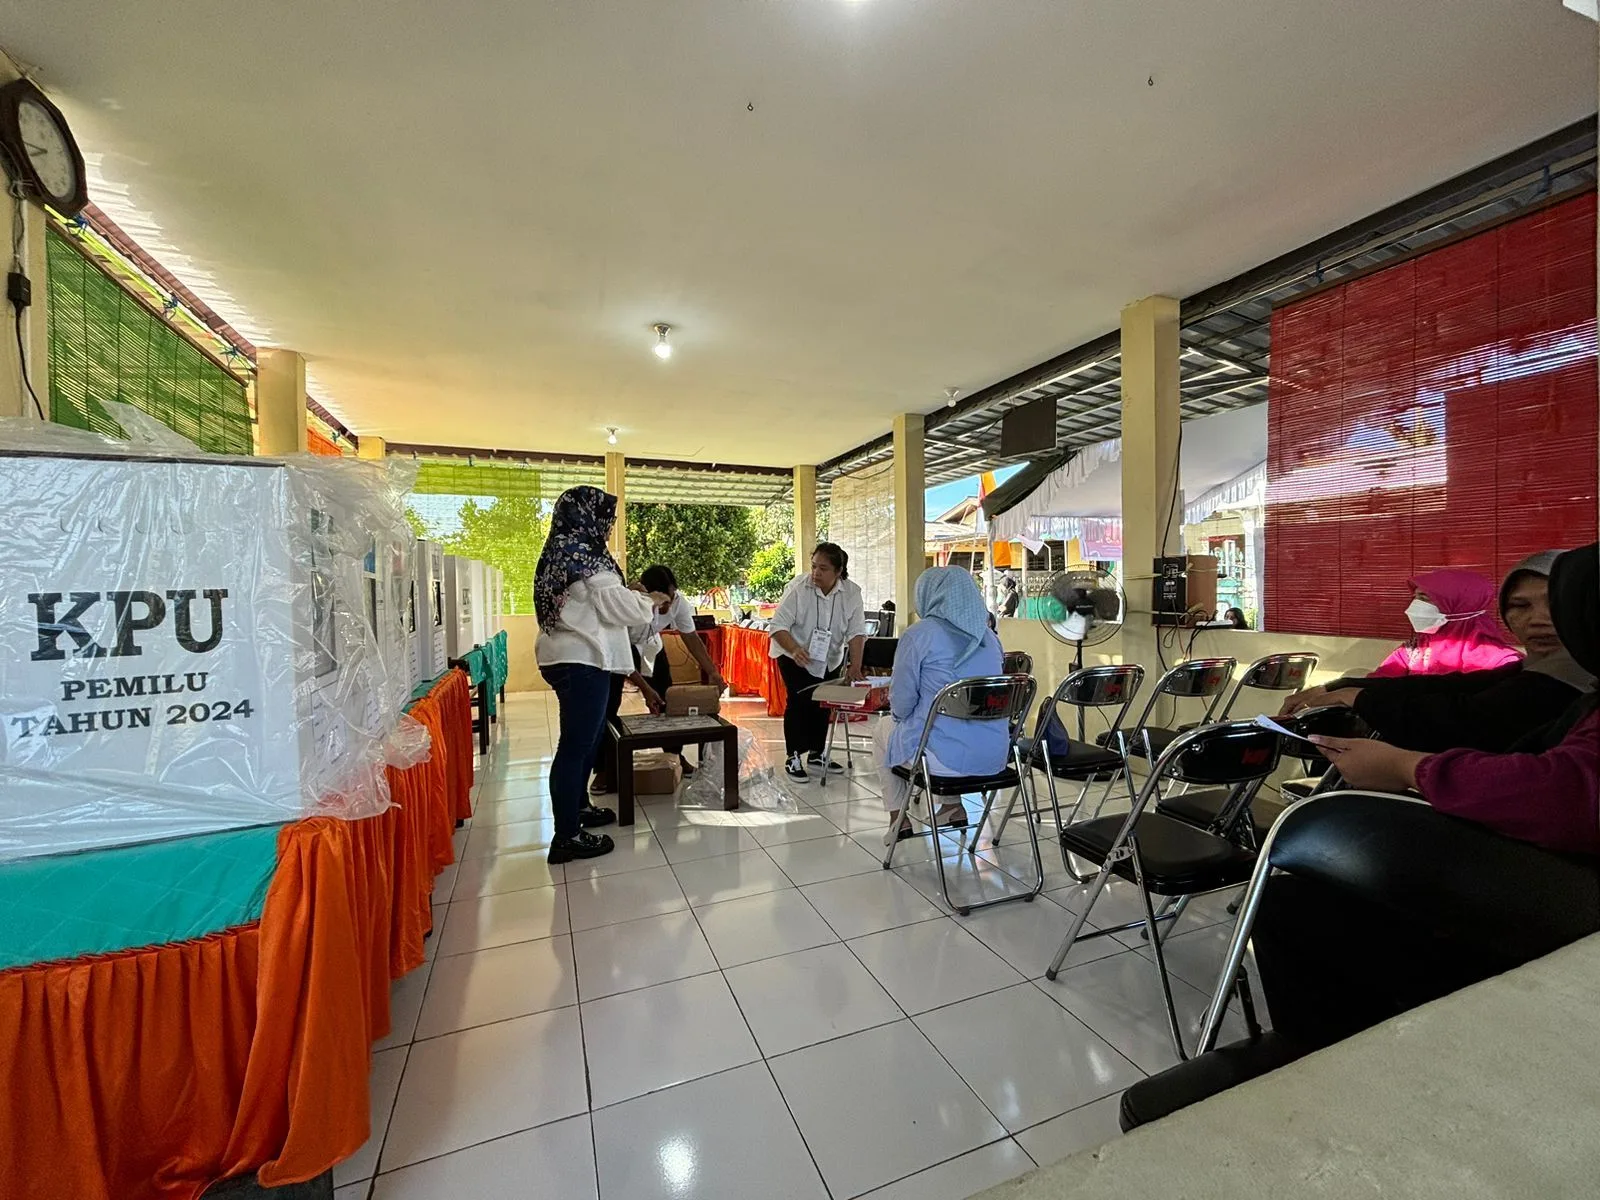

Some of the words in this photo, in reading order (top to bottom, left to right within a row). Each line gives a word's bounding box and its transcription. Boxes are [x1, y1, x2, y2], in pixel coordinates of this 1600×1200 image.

[27, 588, 229, 661] KPU
[60, 671, 208, 701] PEMILU
[11, 707, 152, 738] TAHUN
[166, 699, 254, 725] 2024
